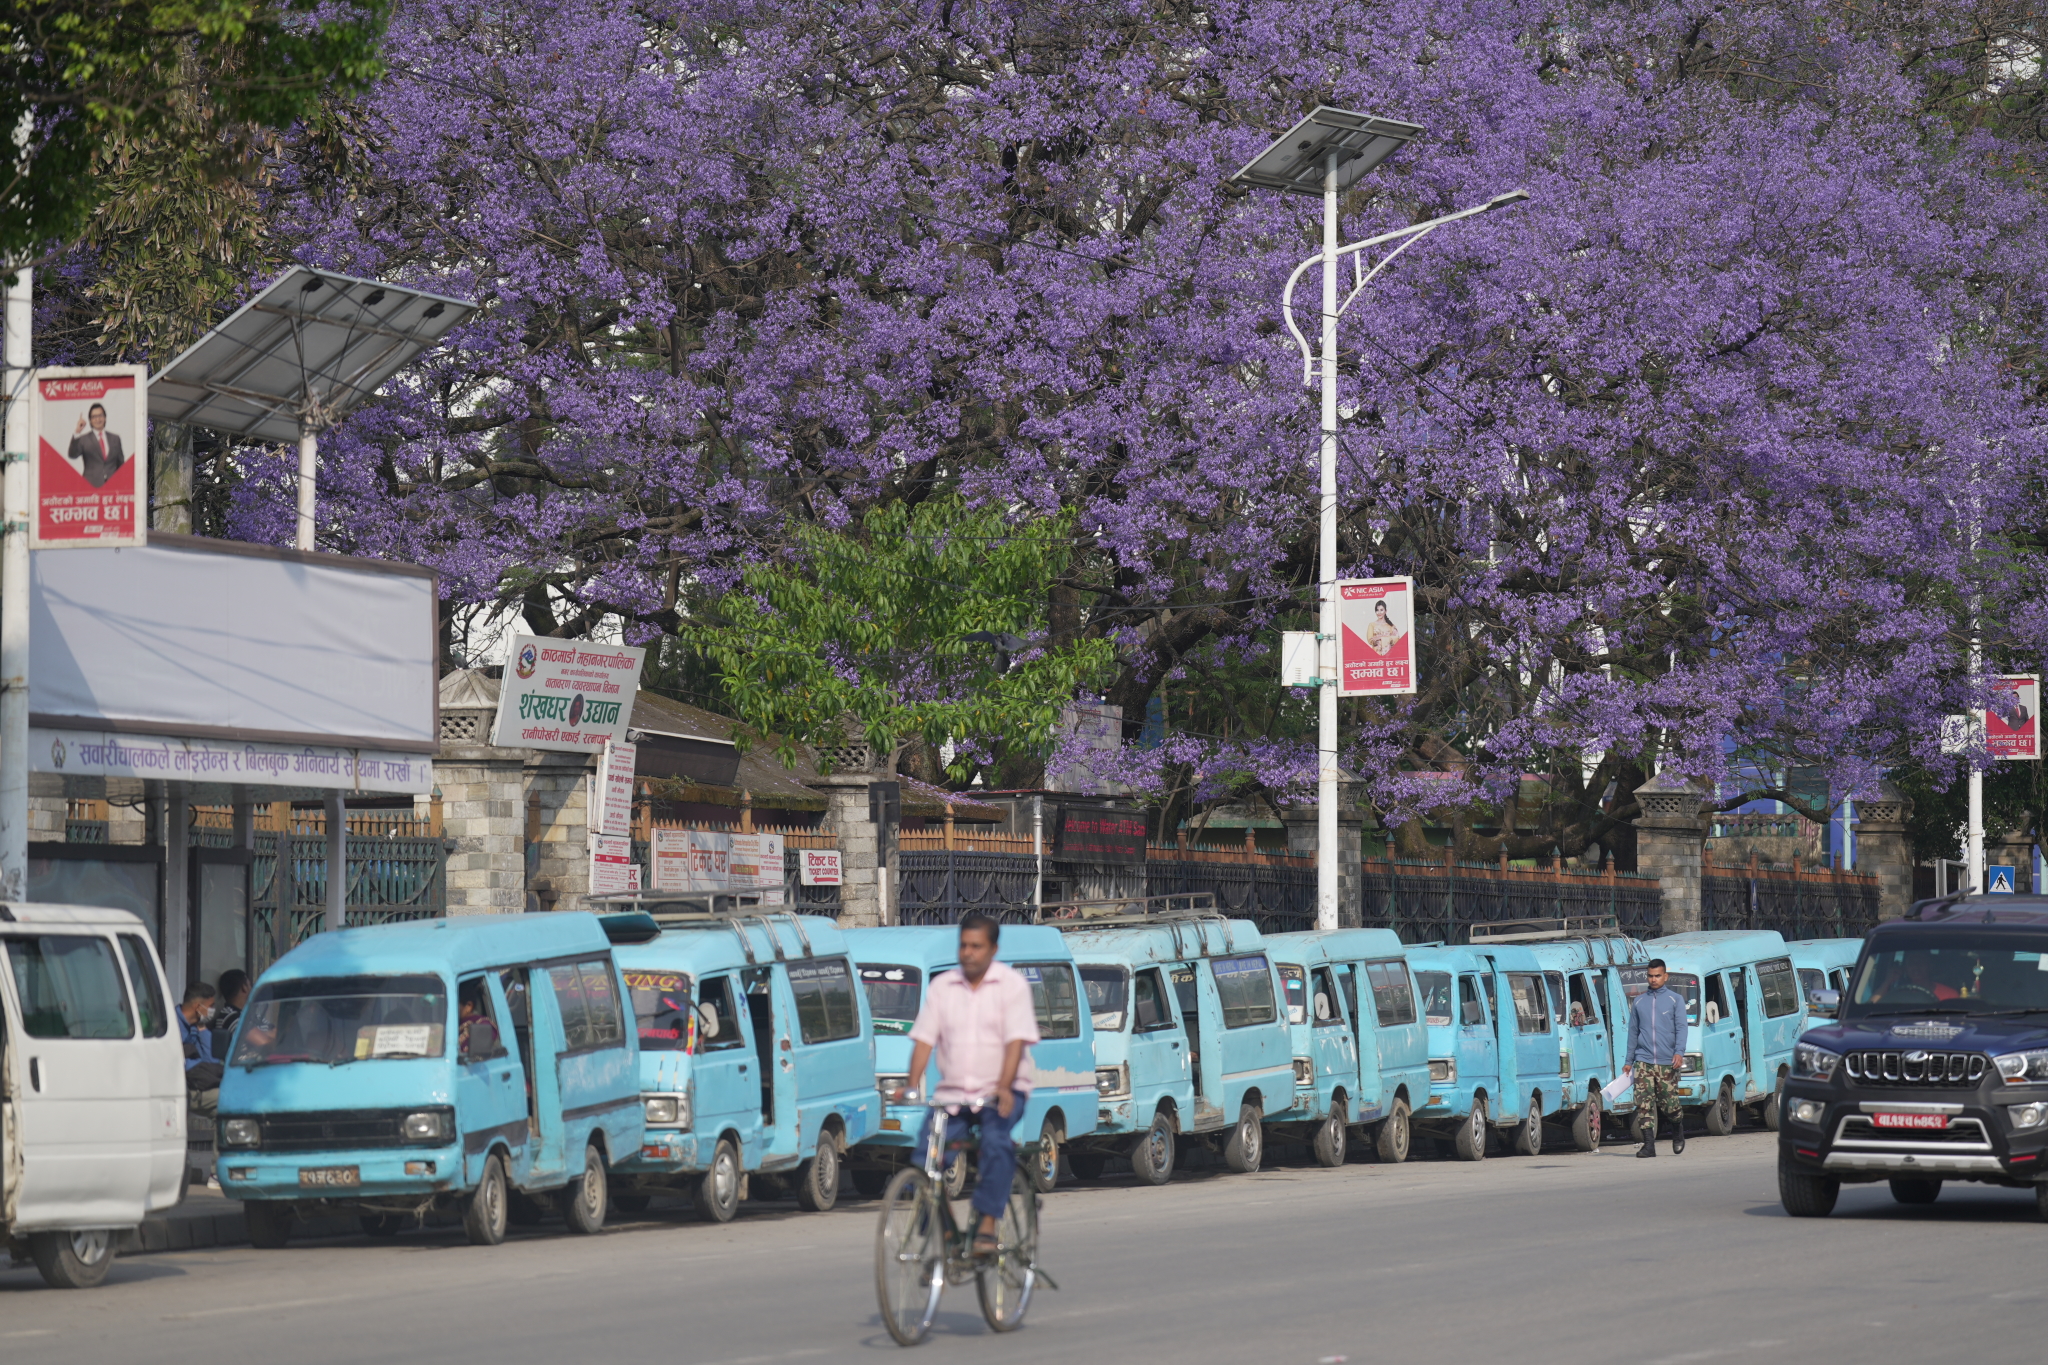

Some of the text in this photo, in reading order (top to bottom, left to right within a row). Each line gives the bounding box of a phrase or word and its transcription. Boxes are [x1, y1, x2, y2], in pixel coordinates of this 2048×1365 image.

[63, 381, 104, 392] NIC ASIA
[50, 506, 99, 524] सम्भव
[541, 647, 636, 670] काठमाडौं महानगरपालिका
[1350, 668, 1384, 679] सम्भव
[545, 678, 572, 690] वातावरण
[602, 680, 621, 694] विभाग
[519, 689, 622, 725] शंखधर उद्यान
[522, 725, 560, 742] रानीपोखरी
[79, 739, 170, 770] सवारीचालकले
[232, 751, 241, 771] र
[245, 746, 289, 776] बिलबुक
[293, 748, 340, 775] अनिवार्य
[1100, 818, 1118, 834] Water
[690, 843, 713, 872] टिकट
[714, 851, 727, 873] घर
[808, 853, 837, 867] टिकट घर
[623, 974, 679, 987] KING
